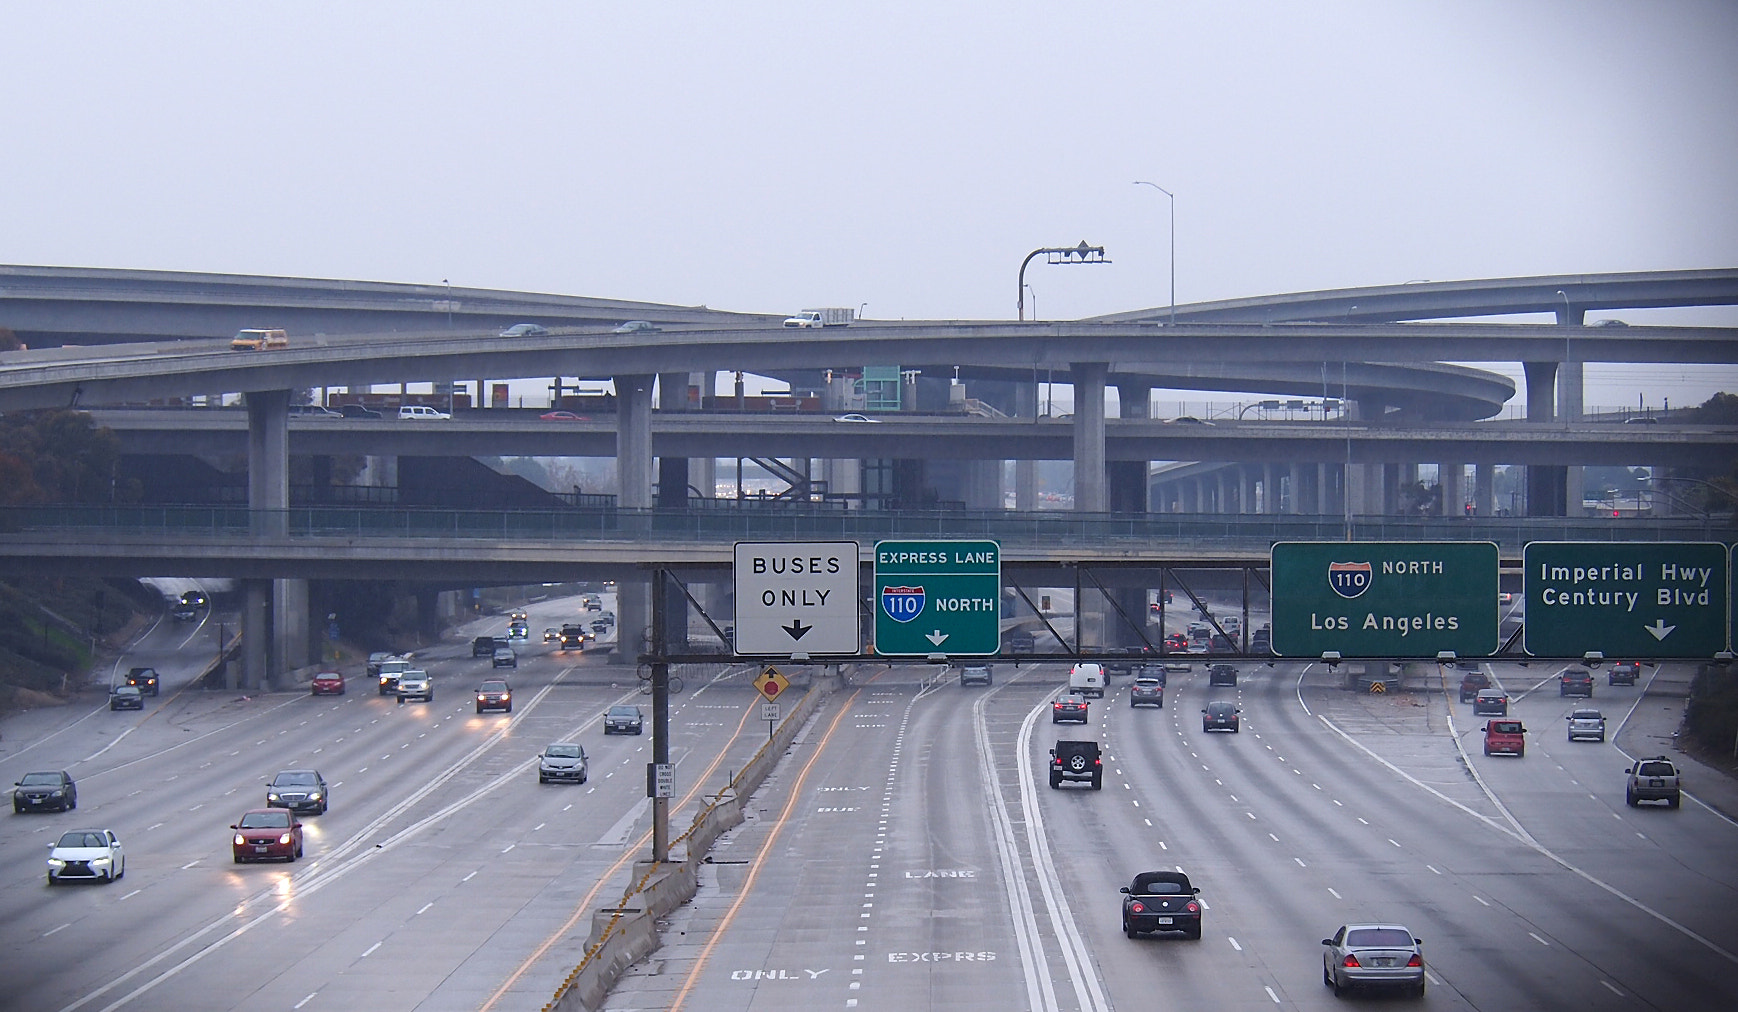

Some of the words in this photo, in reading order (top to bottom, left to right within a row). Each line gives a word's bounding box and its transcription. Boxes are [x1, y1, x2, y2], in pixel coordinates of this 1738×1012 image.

[879, 552, 948, 564] EXPRESS
[955, 552, 995, 564] LANE
[753, 557, 840, 574] BUSES
[1382, 561, 1443, 574] NORTH
[1337, 573, 1365, 587] 110
[1541, 563, 1643, 584] Imperial
[1661, 563, 1712, 588] Hwy
[762, 589, 831, 607] ONLY
[889, 597, 917, 613] 110
[936, 598, 993, 612] NORTH
[1542, 588, 1639, 612] Century
[1657, 588, 1709, 606] Blvd
[1311, 613, 1349, 630] Los
[1362, 612, 1459, 637] Angeles
[905, 870, 975, 879] LANE
[888, 951, 997, 963] EXPRS
[731, 968, 830, 981] ONLY
